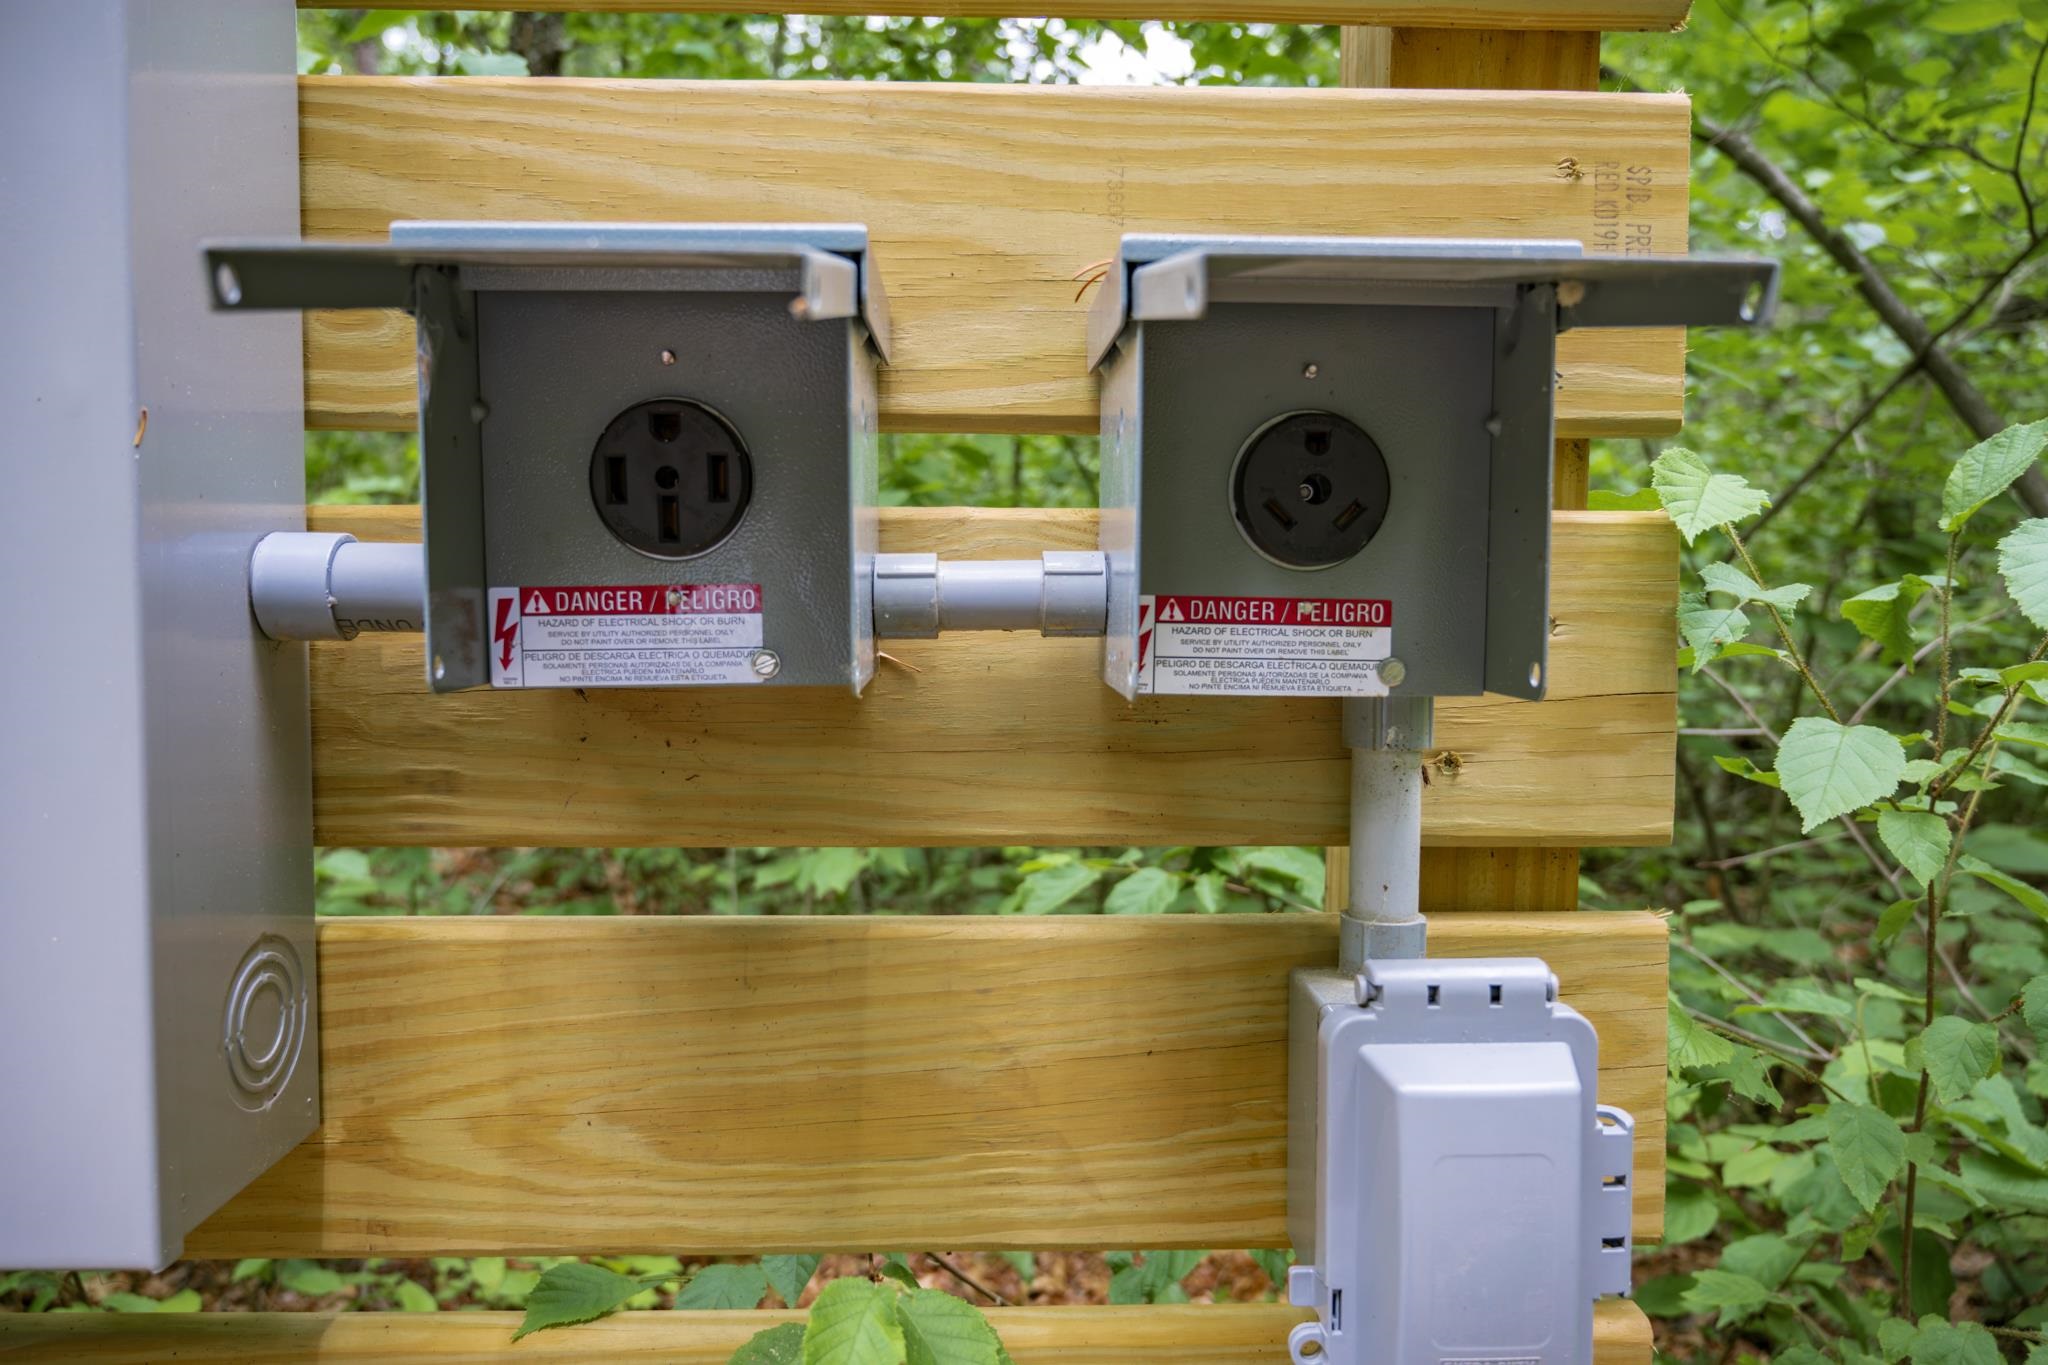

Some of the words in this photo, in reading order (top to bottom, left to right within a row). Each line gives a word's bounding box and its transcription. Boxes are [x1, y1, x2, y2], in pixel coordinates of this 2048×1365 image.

[556, 591, 643, 611] DANGER
[1190, 600, 1275, 621] DANGER
[538, 619, 580, 628] HAZARD
[582, 618, 595, 627] OF
[598, 618, 659, 627] ELECTRICAL
[662, 617, 696, 626] SHOCK
[700, 616, 714, 625] OR
[718, 616, 745, 625] BURN
[1172, 627, 1211, 635] HAZARD
[1214, 628, 1227, 636] OF
[1230, 628, 1289, 637] ELECTRICAL
[1293, 629, 1326, 638] SHOCK
[1329, 630, 1343, 638] OR
[1346, 630, 1373, 638] BURN
[525, 653, 566, 661] PELIGRO
[568, 652, 581, 661] DE
[584, 652, 636, 661] DESCARGA
[638, 651, 690, 660] ELECTRICA
[692, 651, 699, 659] O
[1156, 660, 1196, 668] PELIGRO
[1199, 660, 1211, 668] DE
[1214, 660, 1264, 669] DESCARGA
[1267, 662, 1317, 670] ELECTRICA
[1320, 662, 1327, 670] O
[1258, 671, 1307, 679] AUTORIZADAS
